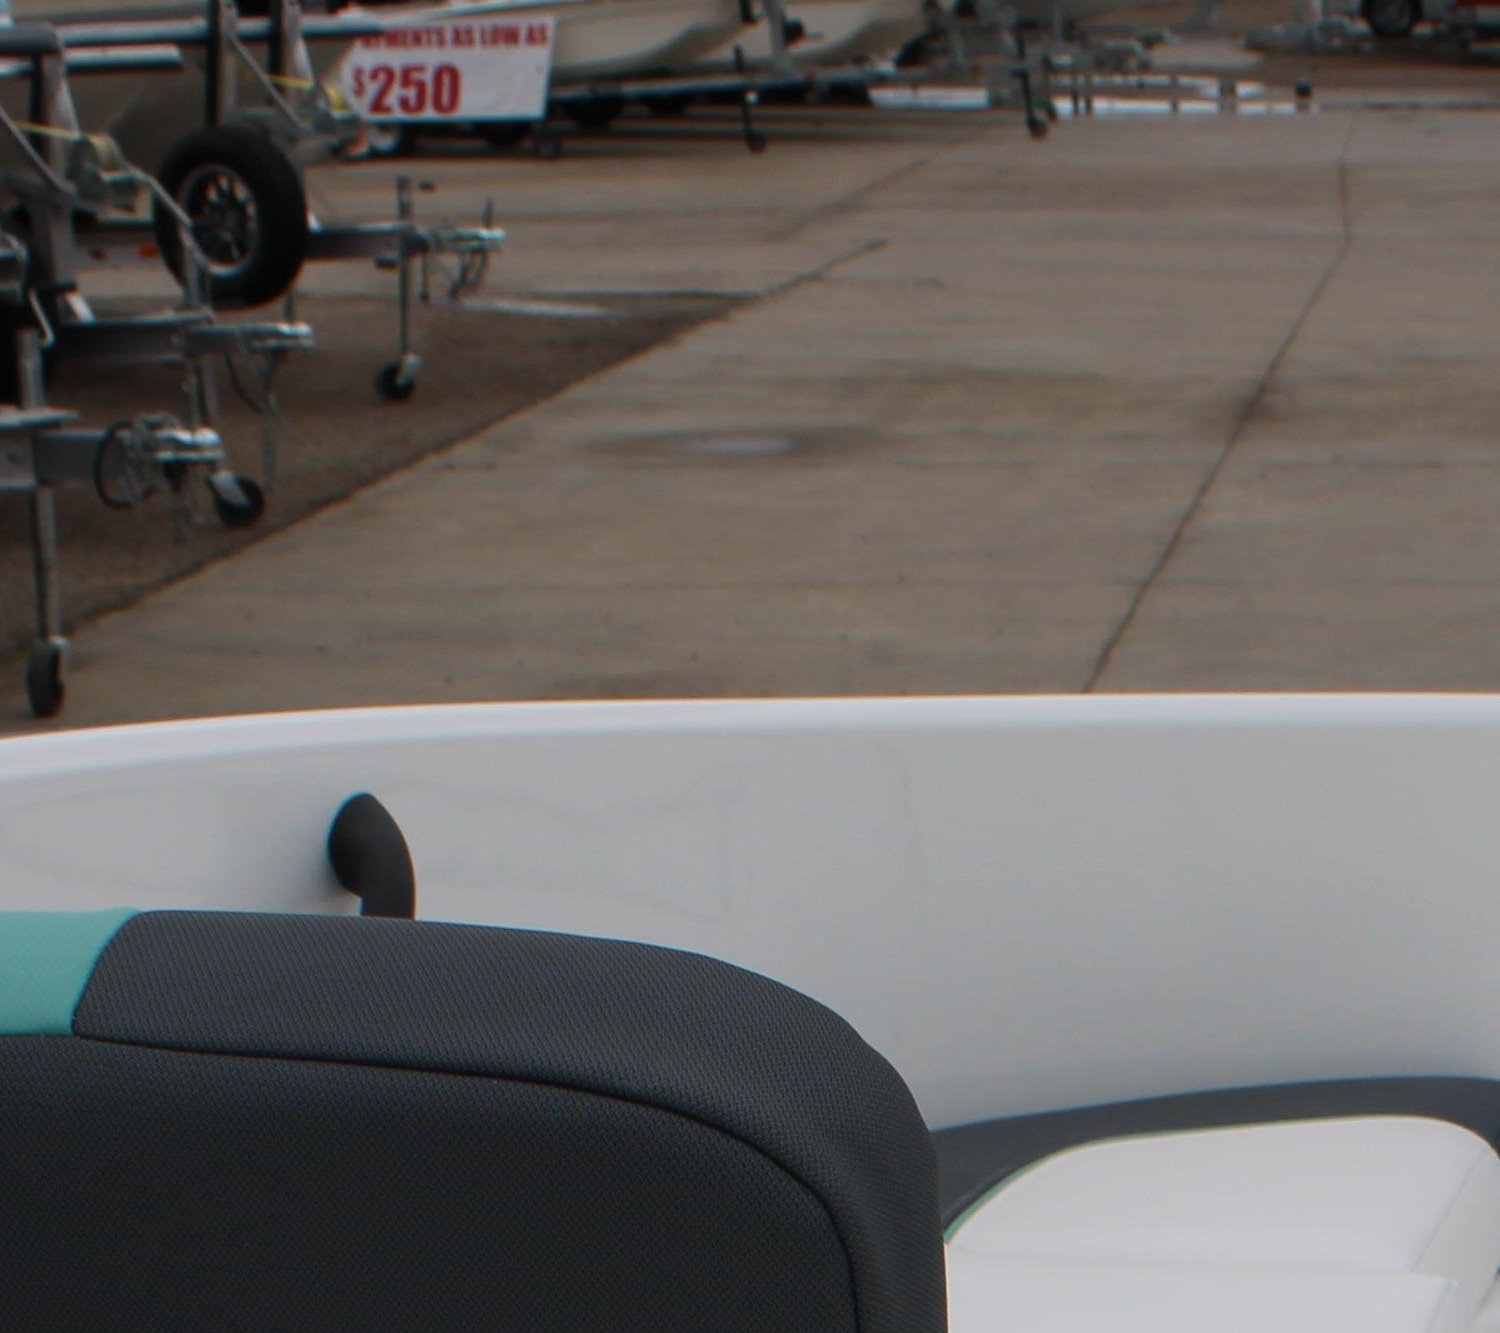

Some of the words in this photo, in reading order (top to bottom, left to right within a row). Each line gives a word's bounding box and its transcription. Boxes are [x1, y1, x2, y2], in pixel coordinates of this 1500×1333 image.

[452, 26, 475, 47] AS
[480, 24, 519, 47] LOW
[525, 23, 548, 46] AS
[352, 64, 462, 115] $250
